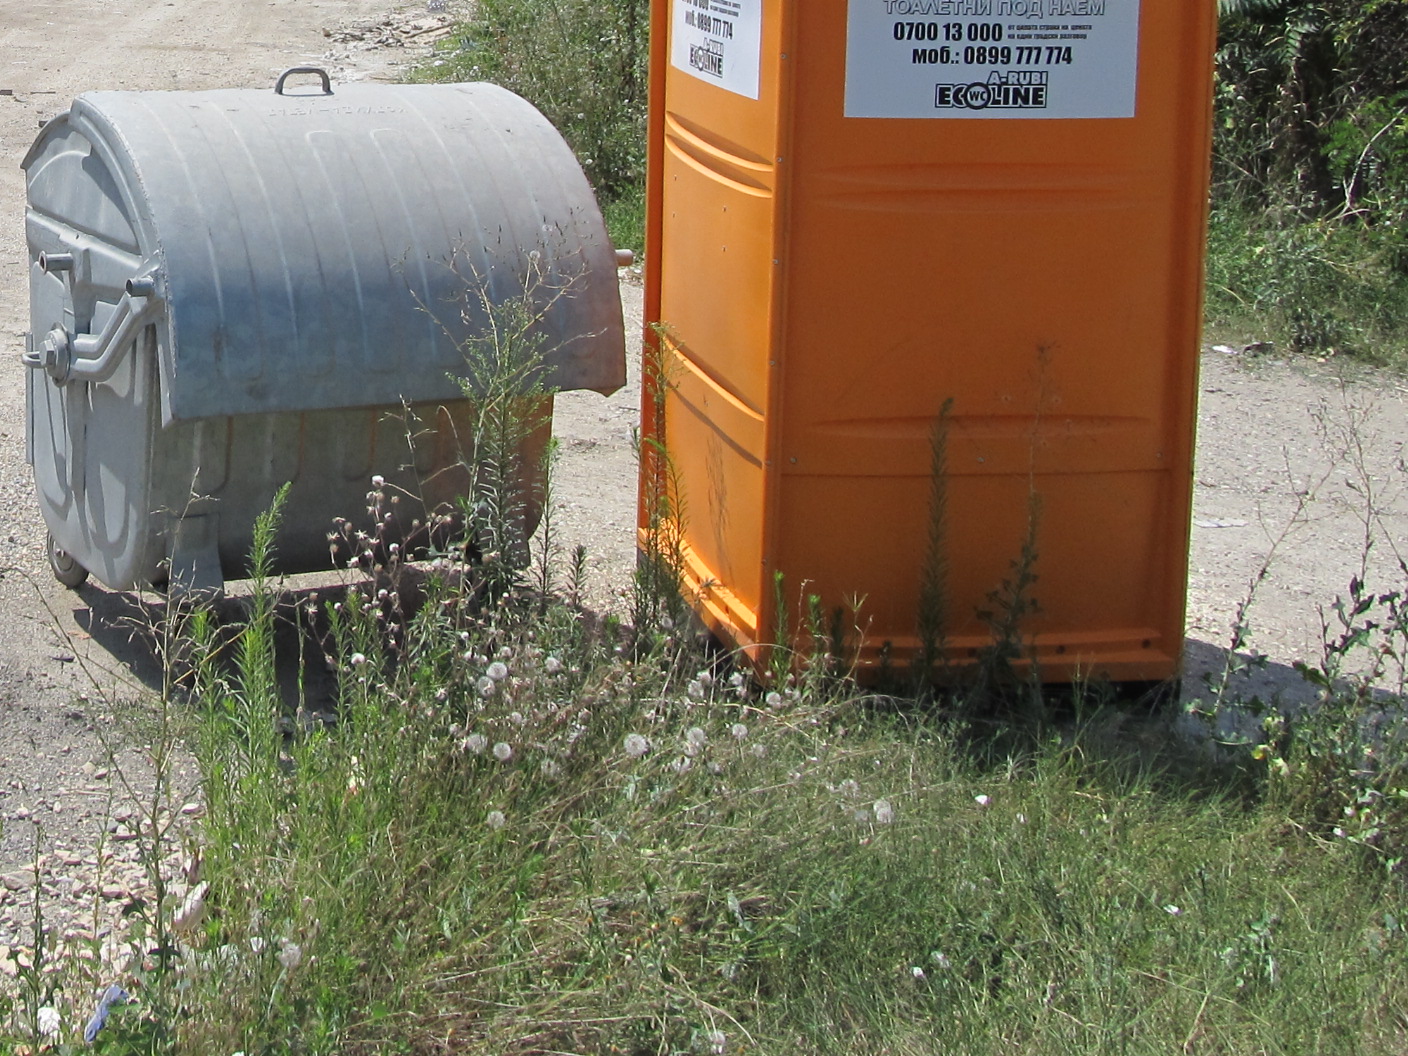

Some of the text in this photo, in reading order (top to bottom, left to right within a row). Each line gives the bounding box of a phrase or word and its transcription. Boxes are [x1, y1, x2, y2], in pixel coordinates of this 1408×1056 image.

[893, 22, 1003, 42] 0700 13 000
[912, 46, 1073, 64] моб.: 0899 777 774
[988, 71, 1048, 85] A-RUBI
